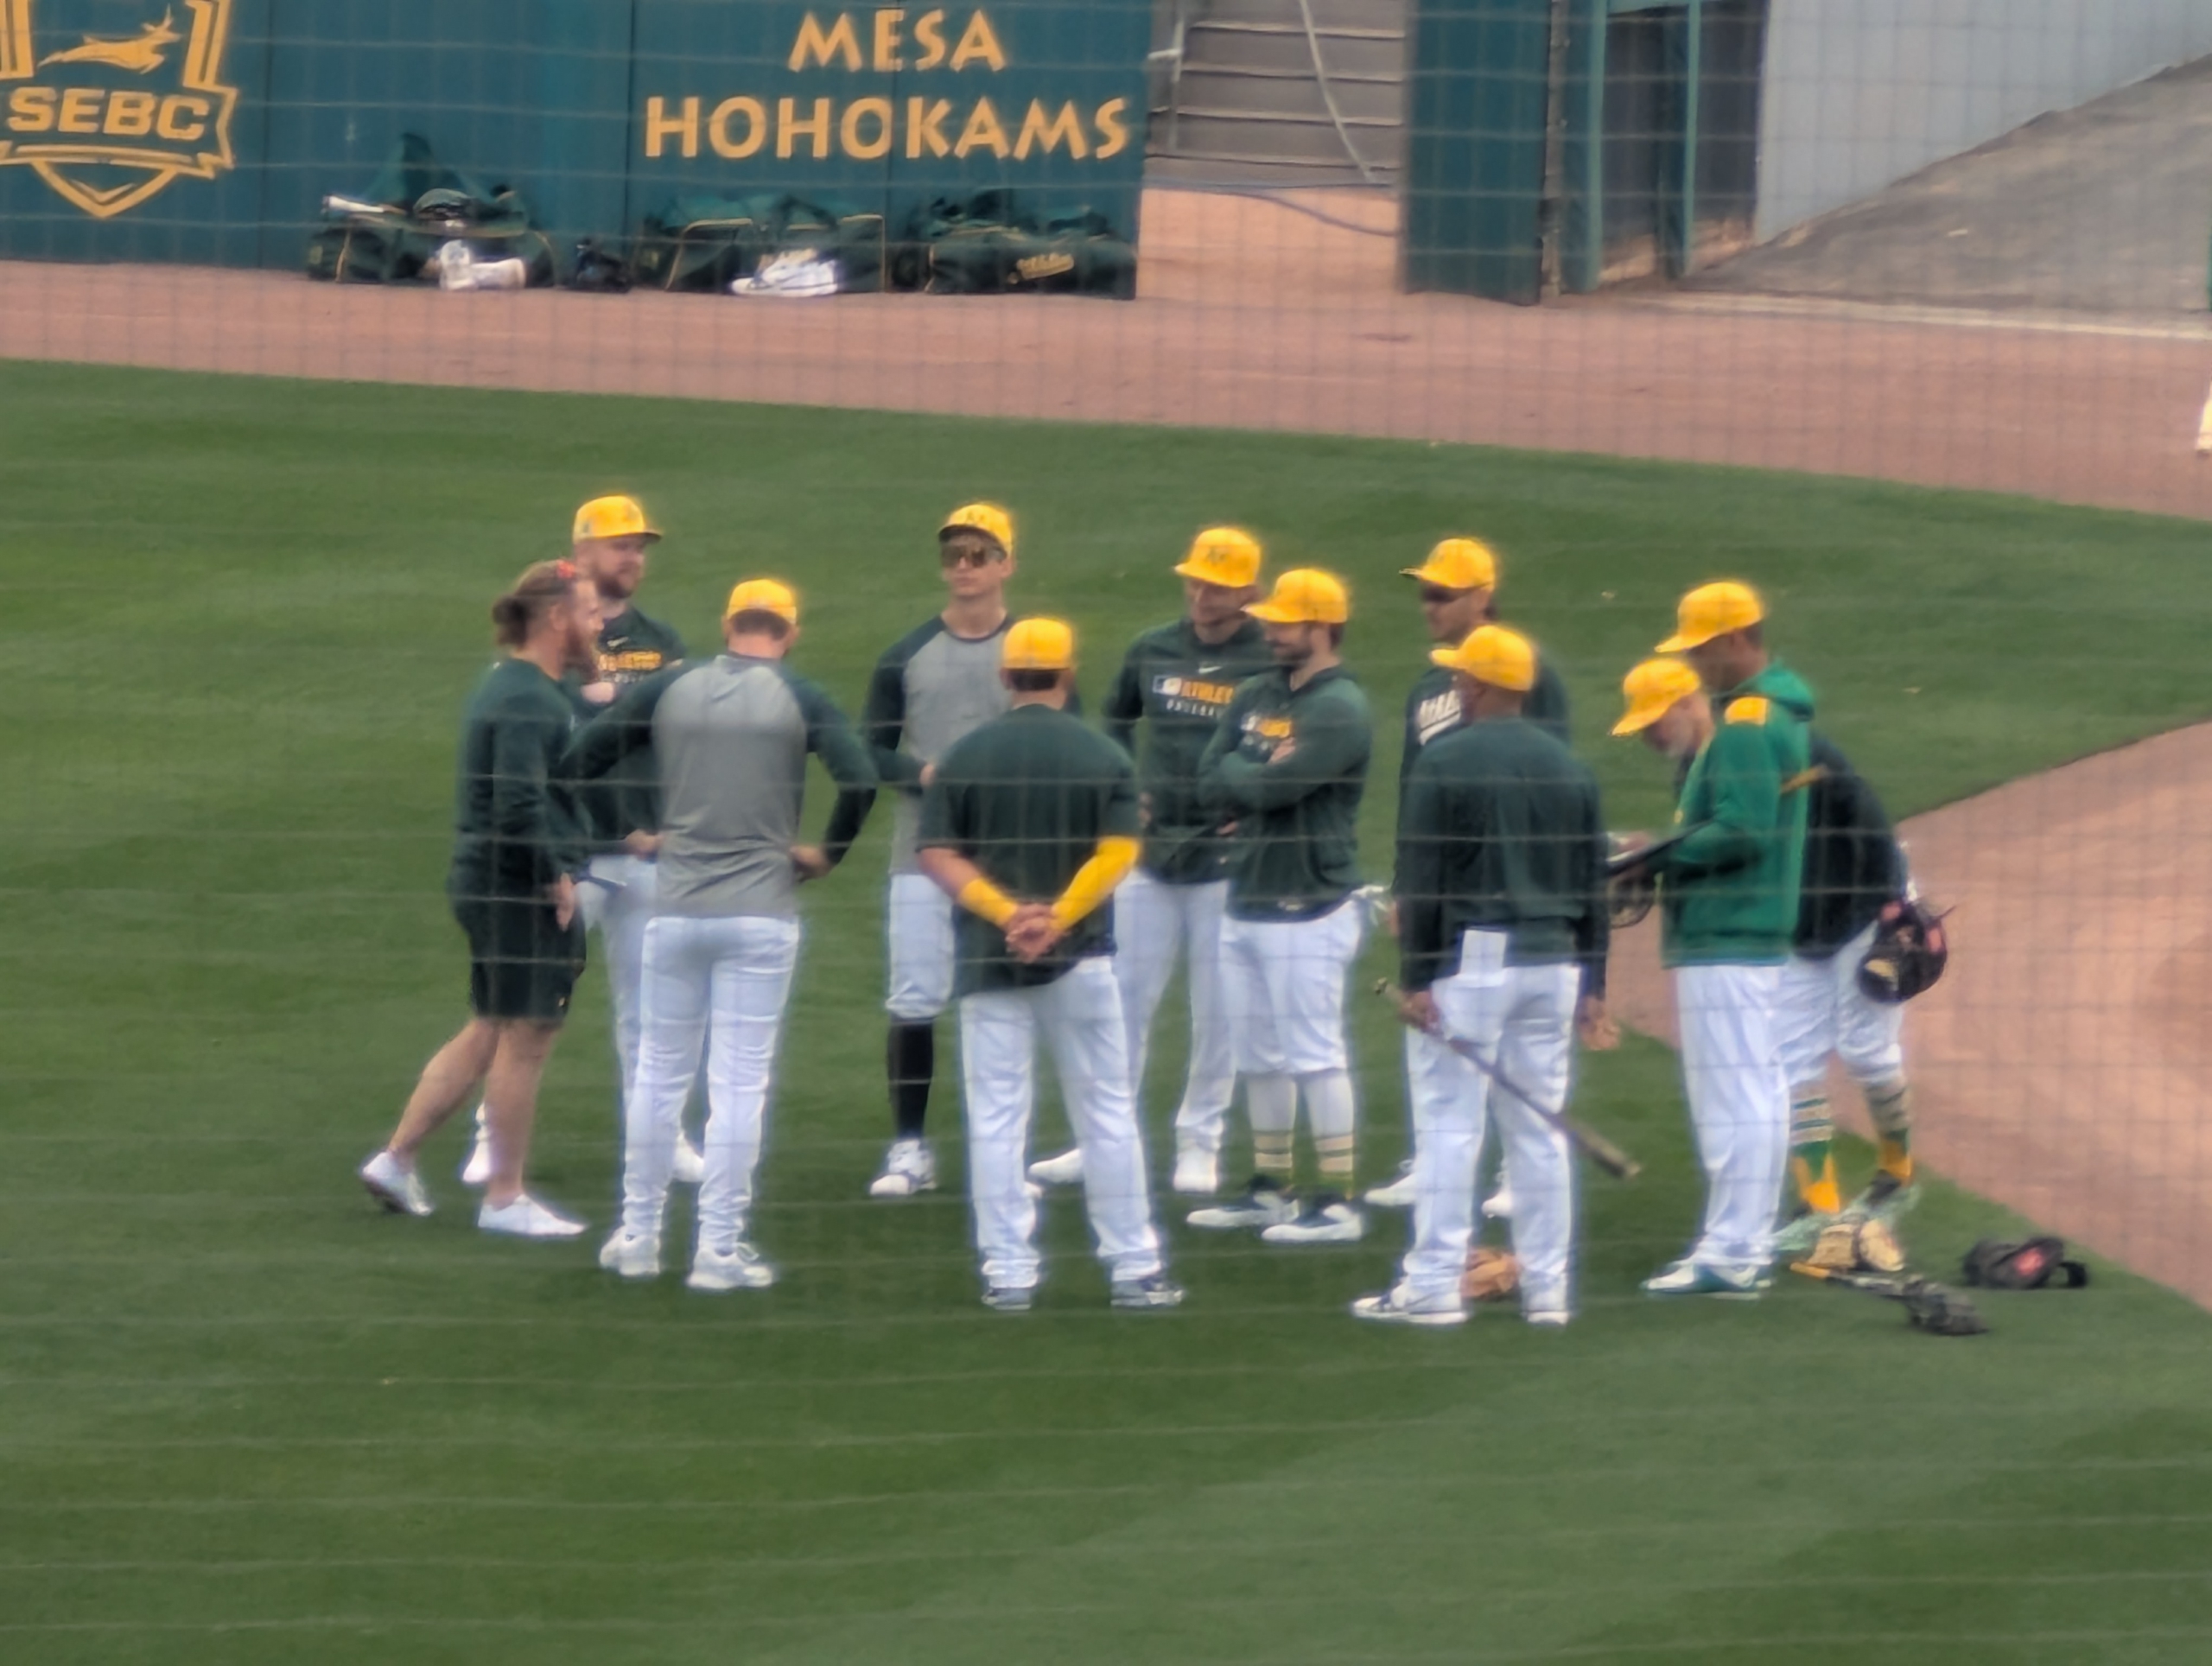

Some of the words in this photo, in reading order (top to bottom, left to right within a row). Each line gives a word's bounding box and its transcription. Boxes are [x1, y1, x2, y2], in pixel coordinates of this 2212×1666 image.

[787, 7, 1007, 73] MESA
[7, 87, 210, 141] SEBC
[645, 95, 1130, 160] HOHOKAMS
